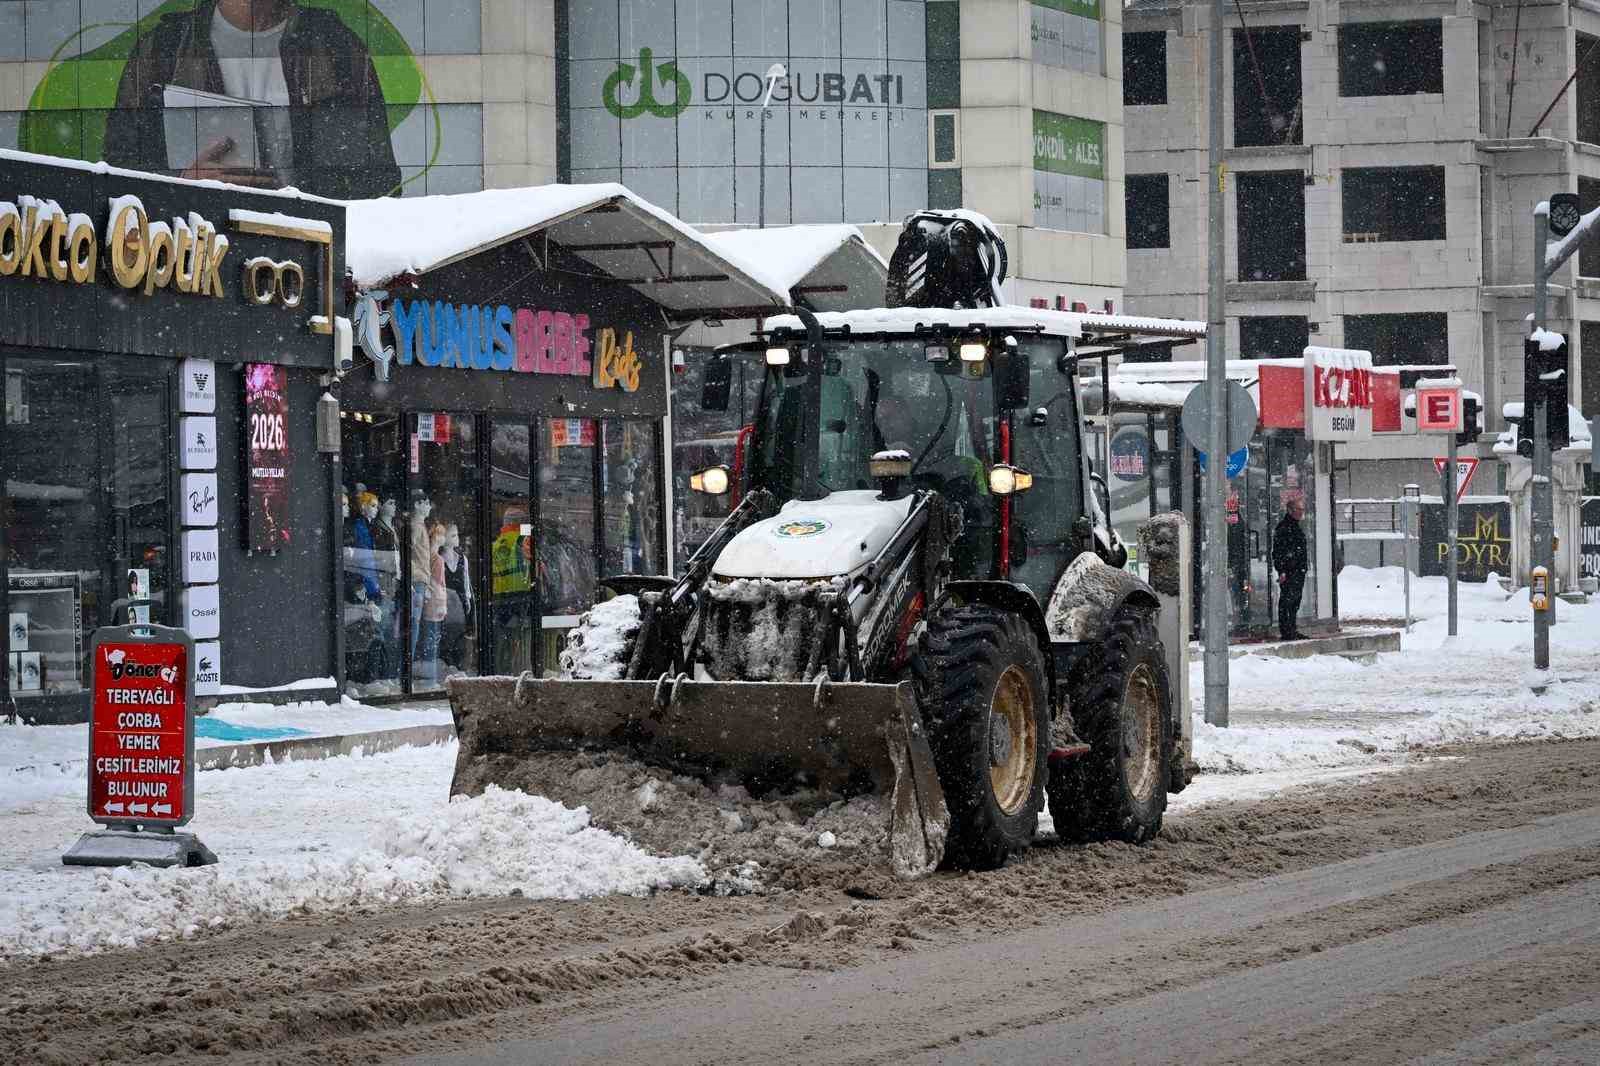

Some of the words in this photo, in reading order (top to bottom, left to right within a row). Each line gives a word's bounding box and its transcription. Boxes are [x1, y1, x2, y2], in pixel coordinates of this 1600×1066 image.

[705, 110, 773, 119] KURS
[106, 195, 229, 298] Optik
[394, 298, 512, 370] YUNUS
[515, 308, 592, 376] BEBE
[1428, 396, 1450, 423] E
[1332, 414, 1355, 431] BEGÜM
[251, 413, 283, 450] 2026
[191, 551, 217, 562] PRADA
[196, 672, 219, 682] ACOSTE
[106, 686, 174, 705] TEREYAĞLI
[117, 713, 161, 729] ÇORBA
[117, 735, 160, 750] YEMEK
[96, 756, 180, 774] ÇEŞİTLERİMİZ
[108, 782, 168, 797] BULUNUR
